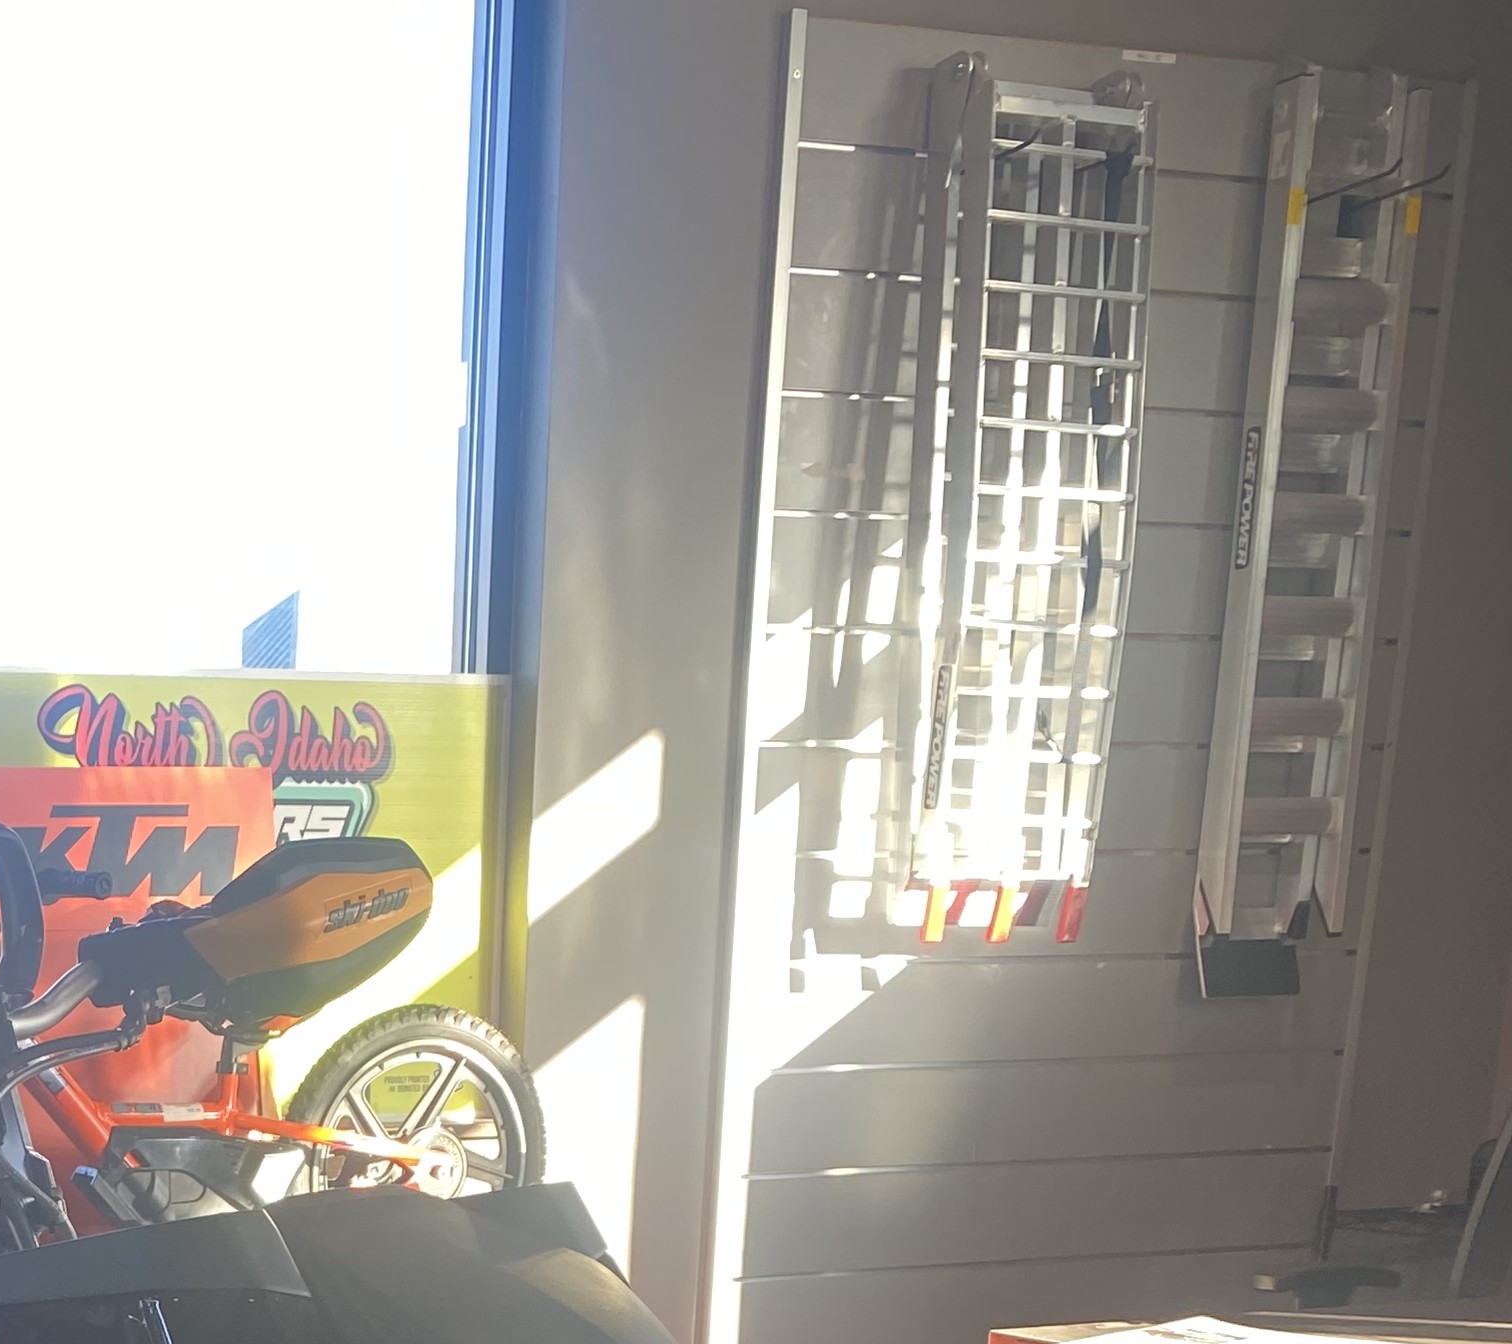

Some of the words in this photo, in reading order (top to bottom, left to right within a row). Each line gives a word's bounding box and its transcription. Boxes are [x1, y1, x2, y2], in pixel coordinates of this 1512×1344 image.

[1237, 483, 1253, 566] POWER
[37, 684, 227, 767] North
[229, 689, 393, 788] Idaho
[323, 887, 410, 933] ski-doo
